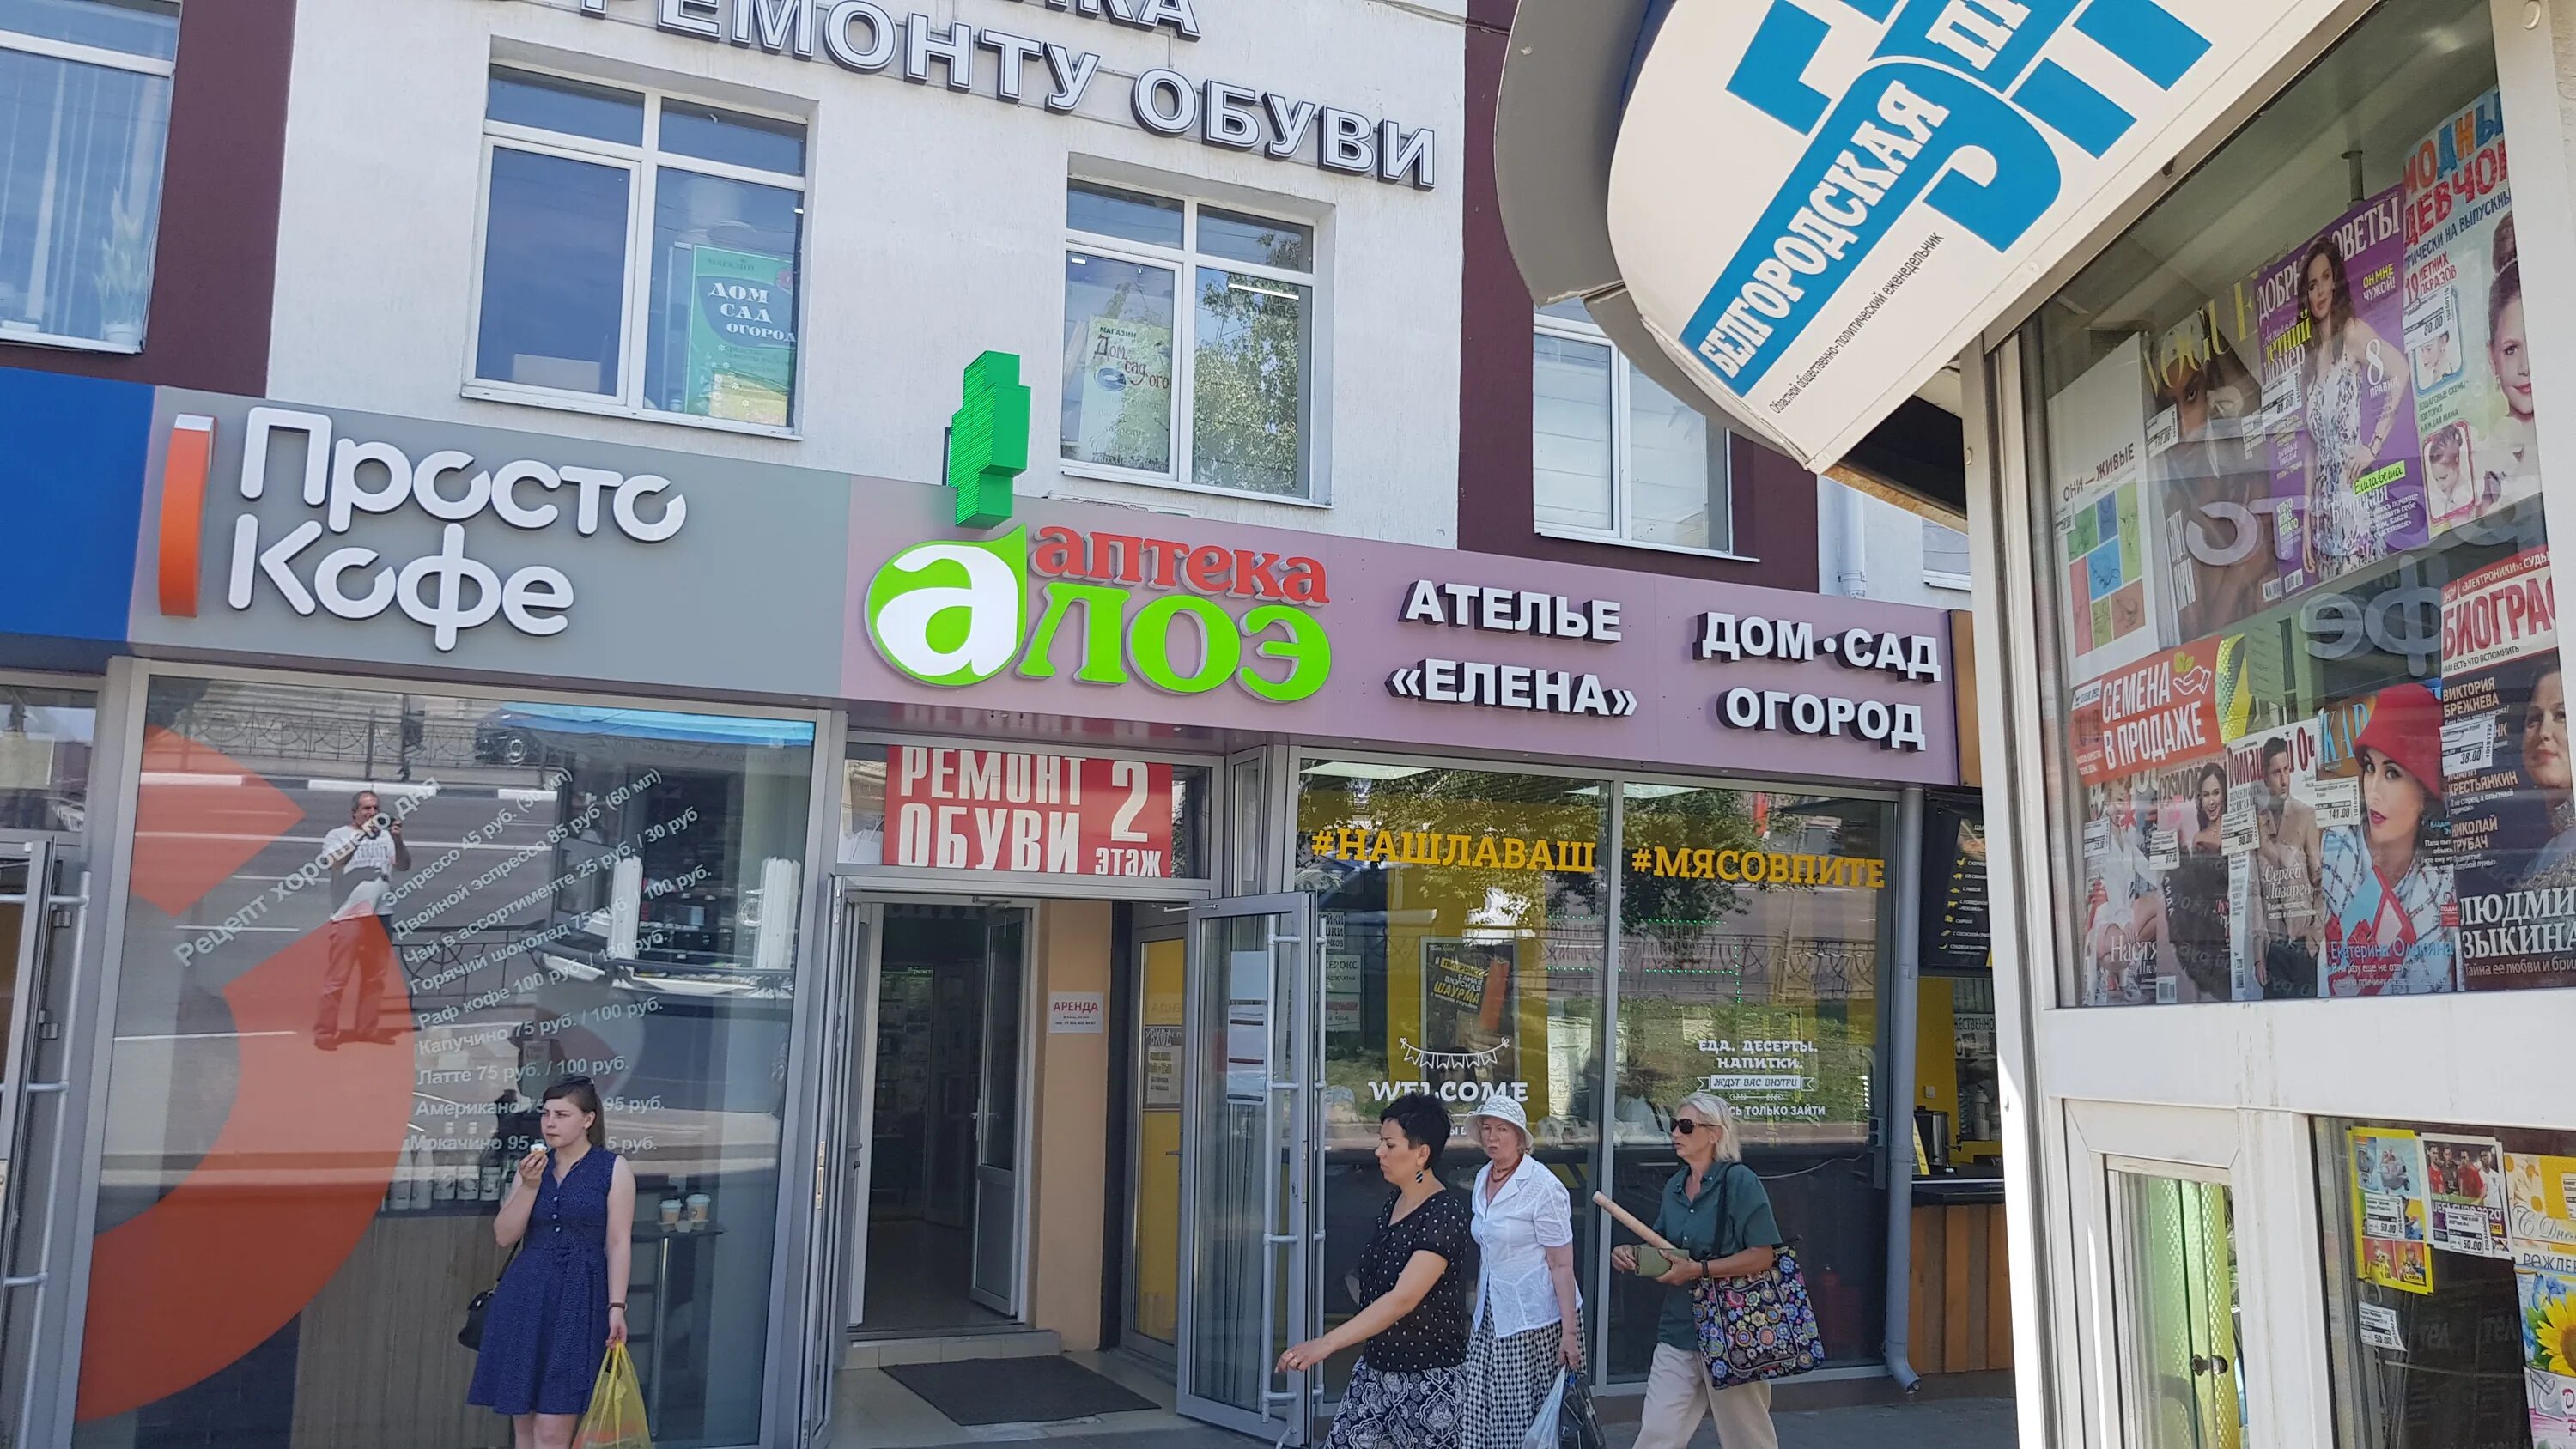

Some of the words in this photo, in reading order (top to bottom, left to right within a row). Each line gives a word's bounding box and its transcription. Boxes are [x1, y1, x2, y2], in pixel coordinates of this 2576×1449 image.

[580, 0, 1101, 114] ЕМОНТУ
[1131, 67, 1436, 192] ОБУВИ
[1698, 80, 1951, 380] БЕЛГОРОДСКАЯ
[2330, 196, 2401, 263] ОВЕТЫ
[2445, 223, 2458, 244] НА
[2362, 271, 2376, 288] ОН
[2374, 263, 2394, 281] МНЕ
[708, 282, 769, 305] ДОМ
[2363, 276, 2396, 302] ЧУЖОЙ!
[720, 302, 773, 324] САД
[1769, 383, 1802, 415] Областной
[1795, 291, 1889, 389] общественно-политический
[1881, 232, 1945, 296] еженедельник
[726, 323, 797, 343] ОГОРОД
[1099, 326, 1137, 339] МАГАЗИН
[2366, 338, 2385, 386] 8
[240, 406, 688, 543] Просто
[2063, 476, 2084, 503] ОНИ
[2096, 442, 2135, 482] ЖИВЫЕ
[1030, 524, 1331, 607] аптека
[228, 512, 574, 653] Кофе
[1399, 579, 1623, 644] АТЕЛЬЕ
[2453, 660, 2467, 670] ЕСТЬ
[2468, 654, 2480, 664] ЧТО
[2480, 645, 2520, 661] ВСПОМНИТЬ
[1385, 658, 1638, 718] «ЕЛЕНА»
[2102, 661, 2171, 724] СЕМЕНА
[2443, 676, 2495, 703] ВИКТОРИЯ
[2443, 692, 2500, 718] БРЕЖНЕВА
[1717, 687, 1926, 753] ОГОРОД
[2104, 730, 2117, 770] В
[2117, 700, 2206, 767] ПРОДАЖЕ
[2459, 749, 2482, 765] 38.00
[900, 744, 1089, 806] РЕМОНТ
[2447, 771, 2518, 797] КРЕСТЬЯНКИН
[1111, 760, 1149, 843] 2
[2328, 807, 2350, 820] 141.00
[897, 802, 1080, 875] ОБУВИ
[2451, 815, 2499, 838] НИКОЛАЙ
[381, 848, 461, 907] Эспрессо
[461, 831, 482, 851] 45
[481, 807, 518, 842] руб.
[393, 883, 471, 941] Двойной
[471, 842, 546, 892] эспрессо
[546, 822, 569, 845] 85
[568, 804, 601, 839] руб
[605, 785, 631, 811] (60
[633, 767, 663, 793] мл)
[1311, 828, 1596, 874] #НАШЛАВАШ
[2452, 834, 2489, 854] ТРУБАЧ
[1631, 846, 1886, 889] #МЯСОВПИТЕ
[2265, 862, 2301, 884] Сергей
[173, 894, 269, 968] Рецепт
[269, 812, 392, 903] хорошего
[403, 937, 441, 967] Чай
[440, 934, 456, 949] в
[459, 873, 576, 943] ассортименте
[576, 858, 598, 878] 25
[600, 840, 636, 874] руб.
[645, 823, 666, 844] 30
[2266, 882, 2312, 900] Лазарев
[410, 953, 488, 996] Горячий
[491, 924, 570, 962] шоколад
[570, 910, 591, 931] 75
[644, 878, 674, 902] 100
[673, 862, 713, 895] руб.
[2330, 940, 2389, 963] Екатерина
[1458, 973, 1483, 986] САМАЯ
[2464, 961, 2491, 977] Тайна
[2492, 963, 2506, 974] ее
[2506, 959, 2542, 976] любви
[2543, 961, 2550, 971] и
[1433, 980, 1480, 1004] ШАУРМА
[1445, 975, 1482, 992] ВКУСНАЯ
[418, 1003, 459, 1030] Раф
[464, 986, 511, 1016] кофе
[514, 972, 544, 994] 100
[1053, 1001, 1099, 1014] АРЕНДА
[418, 1028, 509, 1056] Капучино
[513, 1022, 535, 1037] 75
[539, 1011, 577, 1035] руб.
[591, 1003, 622, 1022] 100
[627, 995, 664, 1022] руб.
[1698, 1040, 1736, 1054] ЕДА.
[1742, 1040, 1820, 1054] ДЕСЕРТЫ.
[416, 1068, 472, 1087] Латте
[477, 1064, 499, 1080] 75
[507, 1061, 542, 1083] руб.
[557, 1058, 588, 1075] 100
[592, 1055, 629, 1076] руб.
[1716, 1057, 1803, 1070] НАПИТКИ.
[1713, 1077, 1741, 1088] ЖДУТ
[1743, 1077, 1761, 1087] ВАС
[1765, 1077, 1798, 1088] ВНУТРИ
[415, 1099, 520, 1119] Американо
[605, 1096, 624, 1112] 95
[629, 1094, 665, 1116] руб.
[1745, 1106, 1788, 1116] ТОЛЬКО
[1790, 1104, 1826, 1116] ЗАЙТИ
[507, 1134, 530, 1150] 95
[622, 1135, 659, 1157] руб.
[2379, 1222, 2397, 1234] 50.00
[2463, 1239, 2482, 1252] 50.00
[2373, 1333, 2393, 1347] 50.00
